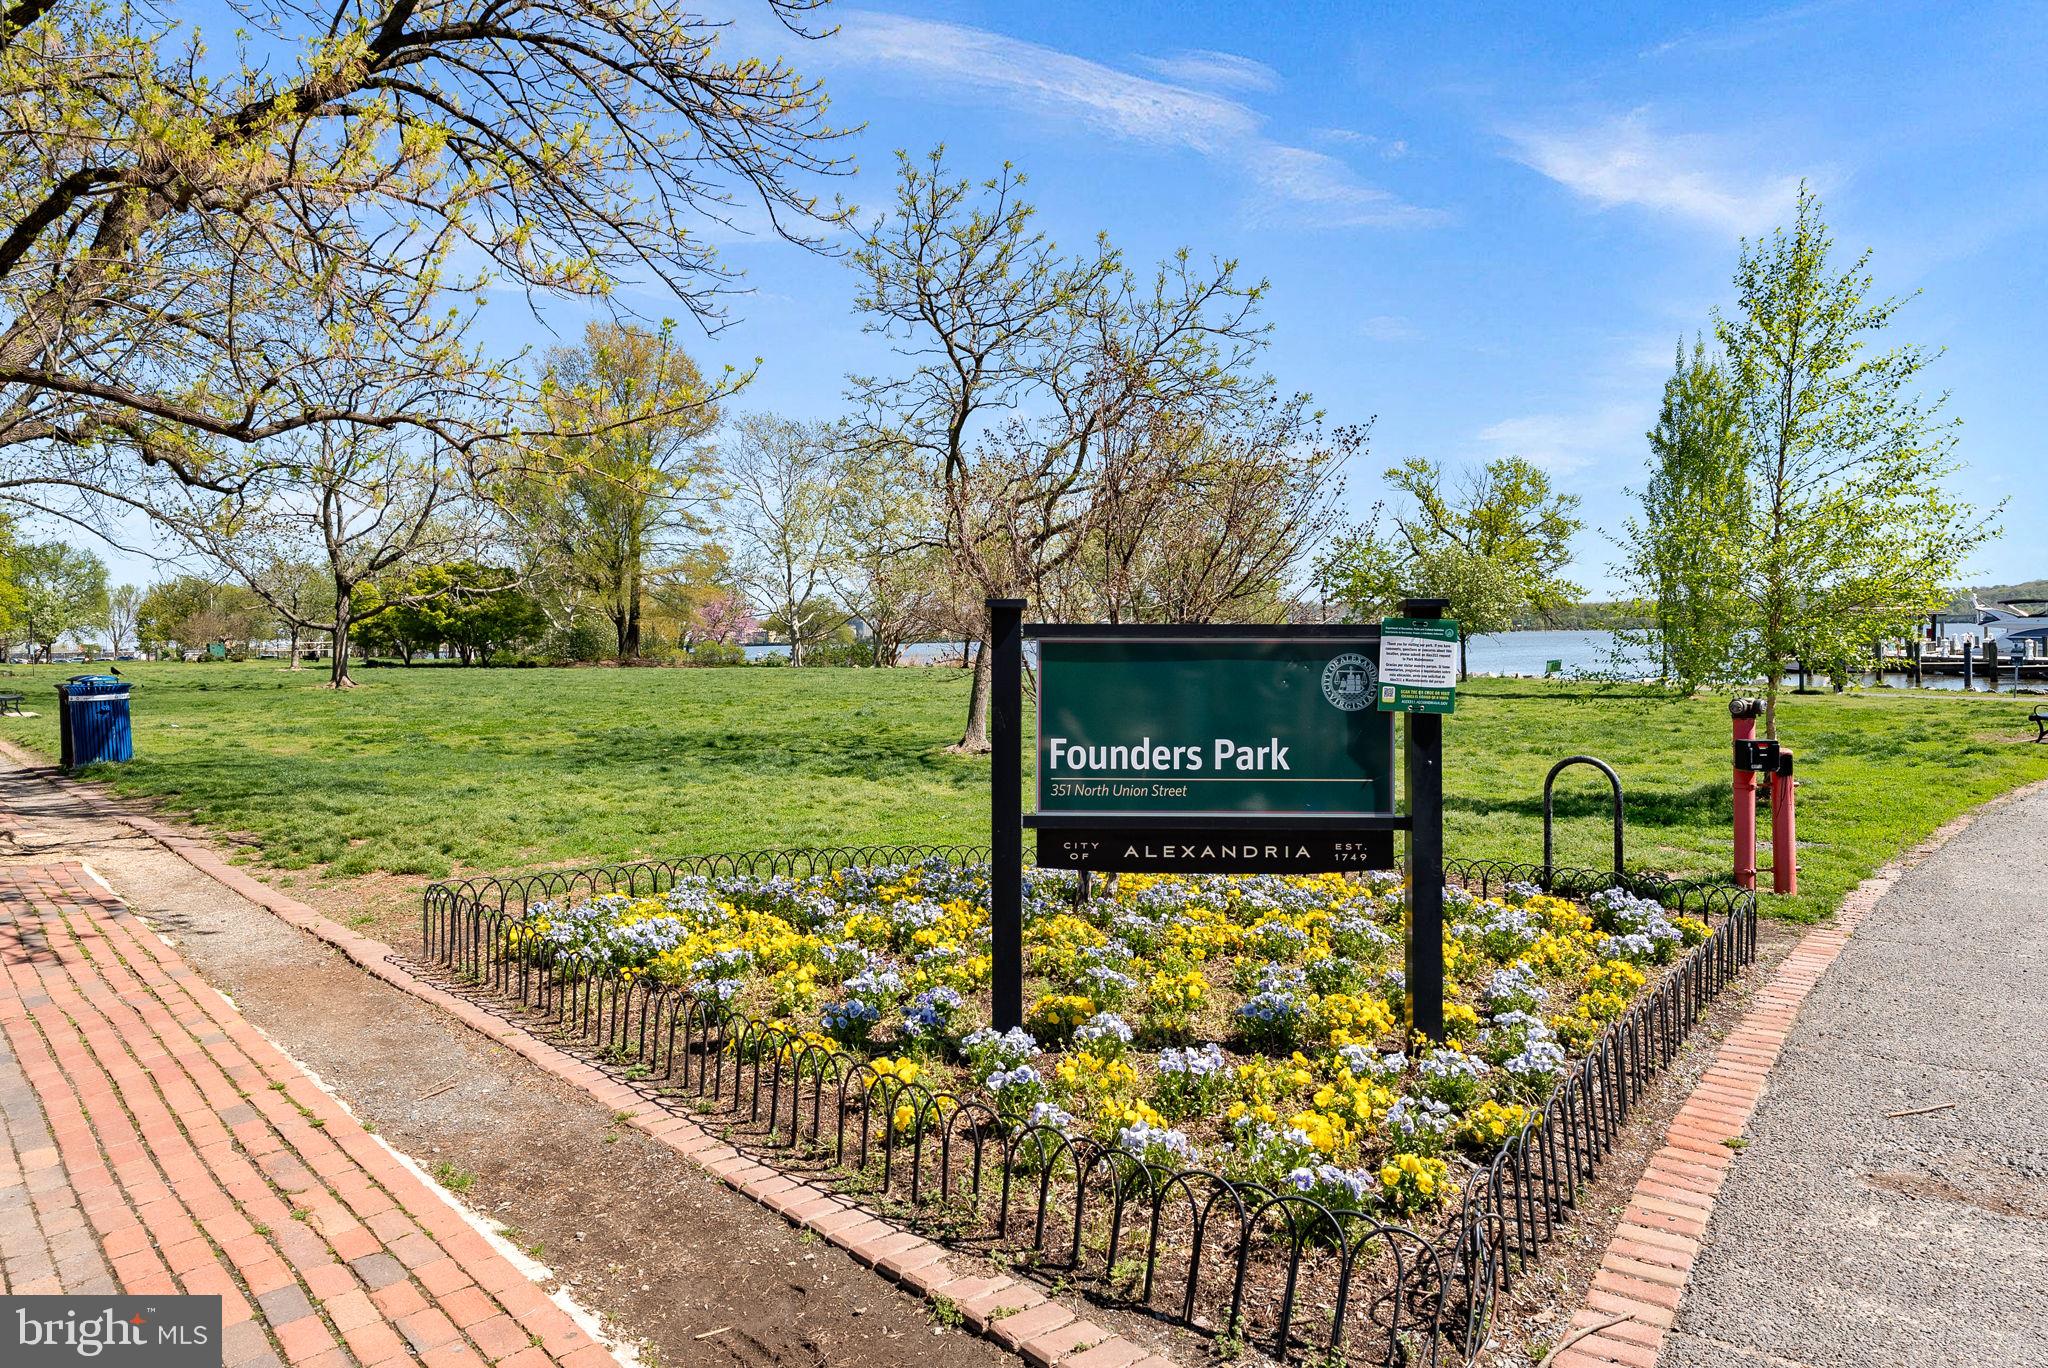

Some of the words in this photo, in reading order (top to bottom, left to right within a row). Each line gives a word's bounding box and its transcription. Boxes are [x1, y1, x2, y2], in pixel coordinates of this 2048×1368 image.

[1050, 737, 1203, 770] Founders
[1214, 738, 1290, 770] Park
[1051, 784, 1071, 796] 351
[1075, 784, 1109, 796] North
[1113, 784, 1148, 797] Union
[1152, 785, 1187, 797] Street
[1064, 842, 1100, 850] CITY
[1124, 845, 1311, 858] ALEXANDRIA
[1334, 853, 1367, 861] 1749
